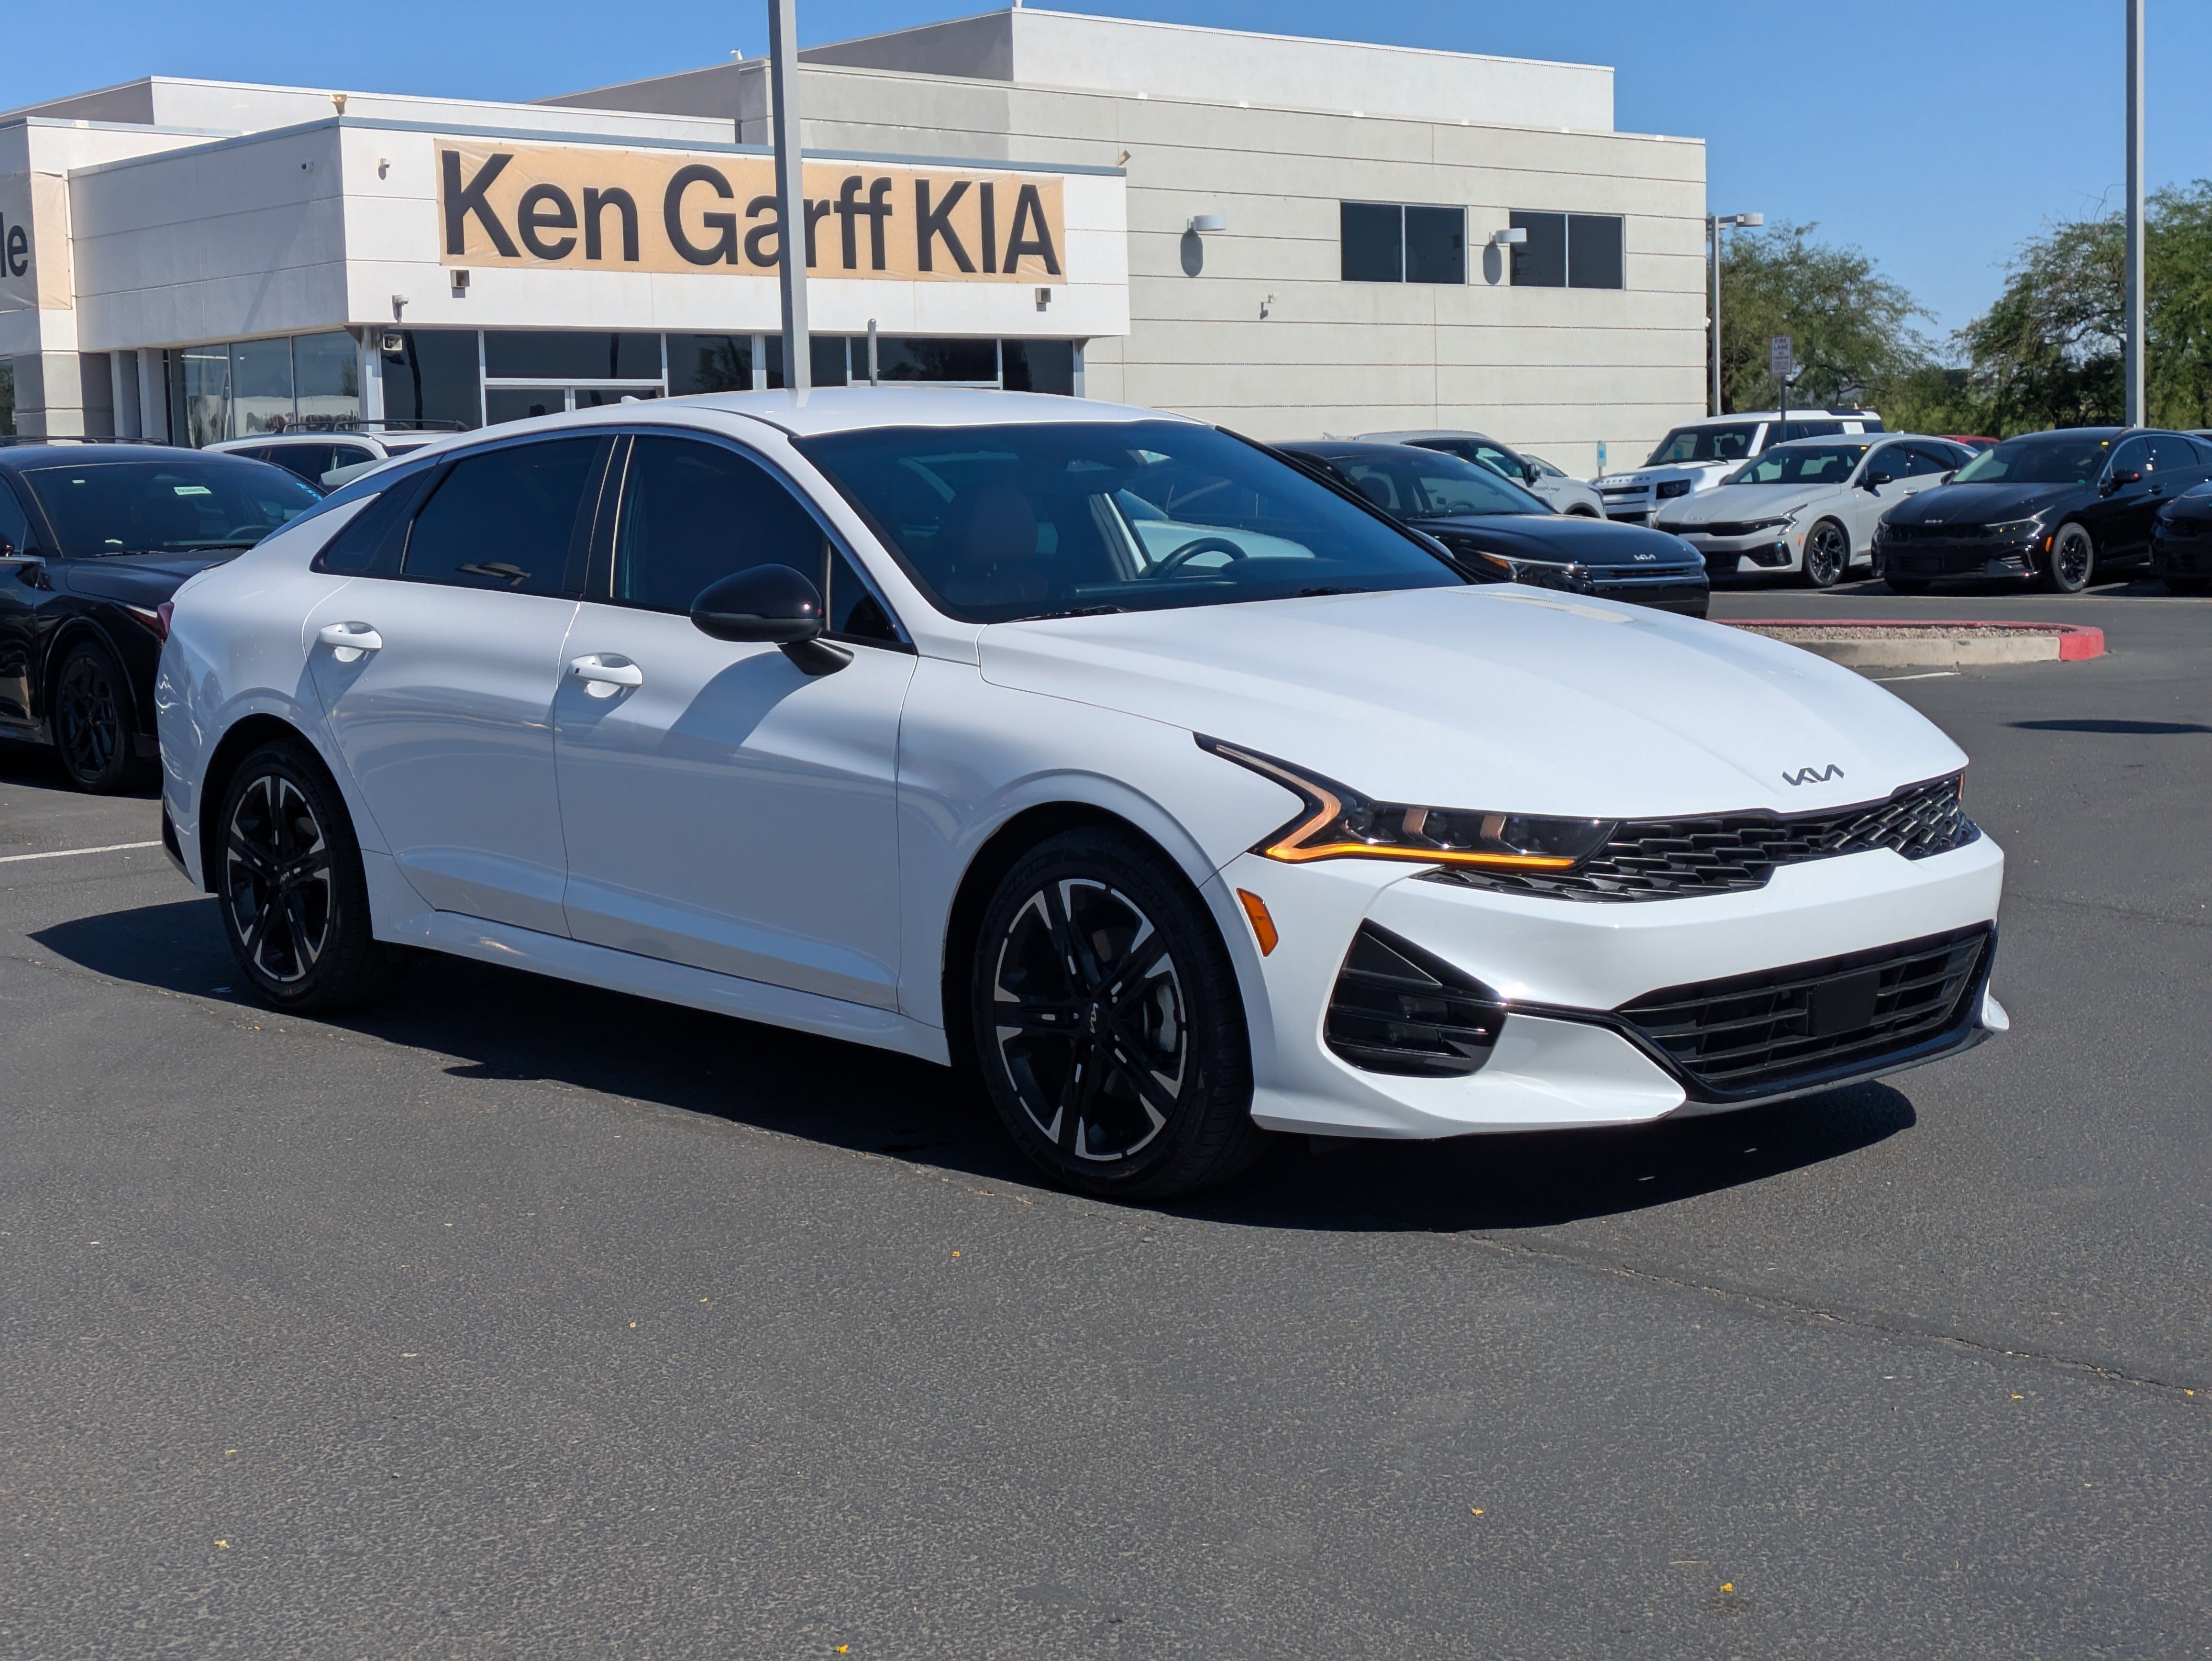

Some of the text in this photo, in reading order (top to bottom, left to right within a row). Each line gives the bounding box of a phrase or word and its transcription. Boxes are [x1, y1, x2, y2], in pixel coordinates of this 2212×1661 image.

[442, 150, 1062, 275] Ken Garff KIA
[1782, 764, 1845, 786] KIA
